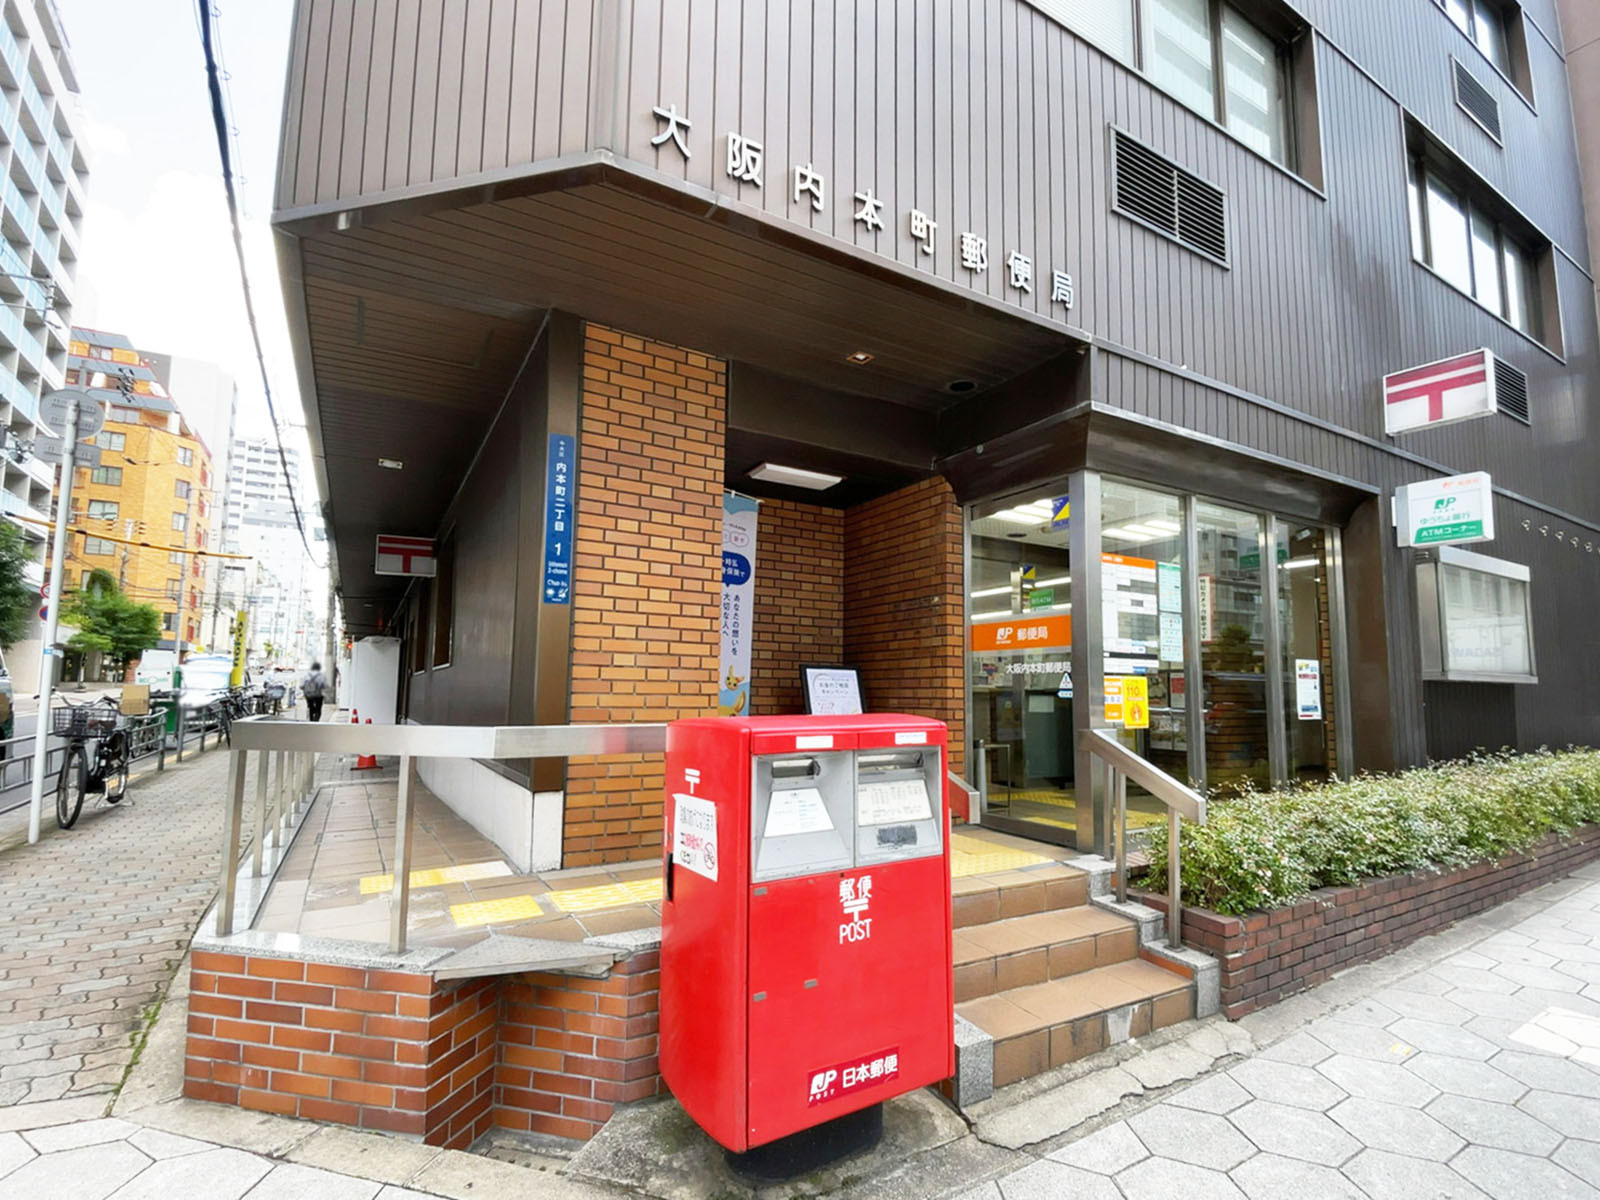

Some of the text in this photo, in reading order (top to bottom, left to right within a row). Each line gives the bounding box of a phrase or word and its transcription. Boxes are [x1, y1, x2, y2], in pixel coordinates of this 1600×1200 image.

[651, 104, 1074, 310] 大阪内本町郵便局
[554, 462, 567, 532] 内本町二丁目
[1434, 497, 1457, 510] JP
[554, 543, 562, 556] 1
[722, 592, 731, 636] 大切な人へ
[732, 594, 740, 656] あなたの想いを
[1017, 626, 1048, 641] 郵便局
[1006, 661, 1072, 674] 大阪内本町郵便局
[839, 875, 873, 903] 郵便
[839, 918, 873, 945] POST
[810, 1054, 898, 1095] JP 日本郵便
